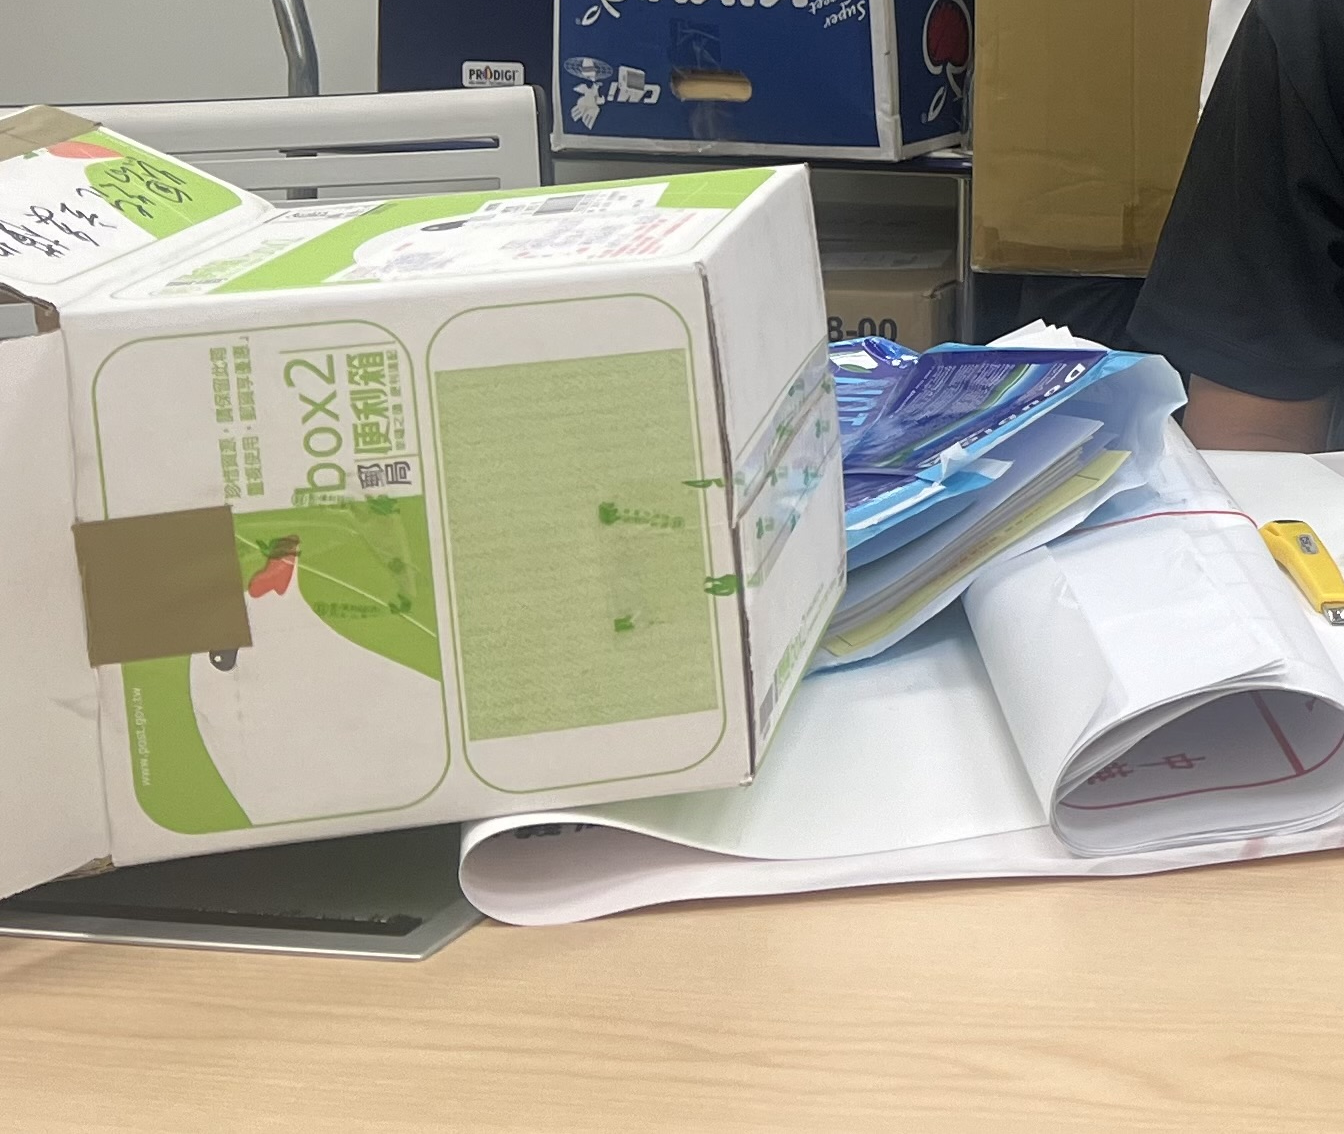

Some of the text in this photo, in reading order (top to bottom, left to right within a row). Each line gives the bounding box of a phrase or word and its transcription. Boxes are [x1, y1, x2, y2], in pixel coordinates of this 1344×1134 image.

[823, 0, 867, 29] Super
[347, 352, 392, 454] 便利箱
[357, 460, 412, 490] 郵局
[132, 687, 151, 786] www.post.gov.tw
